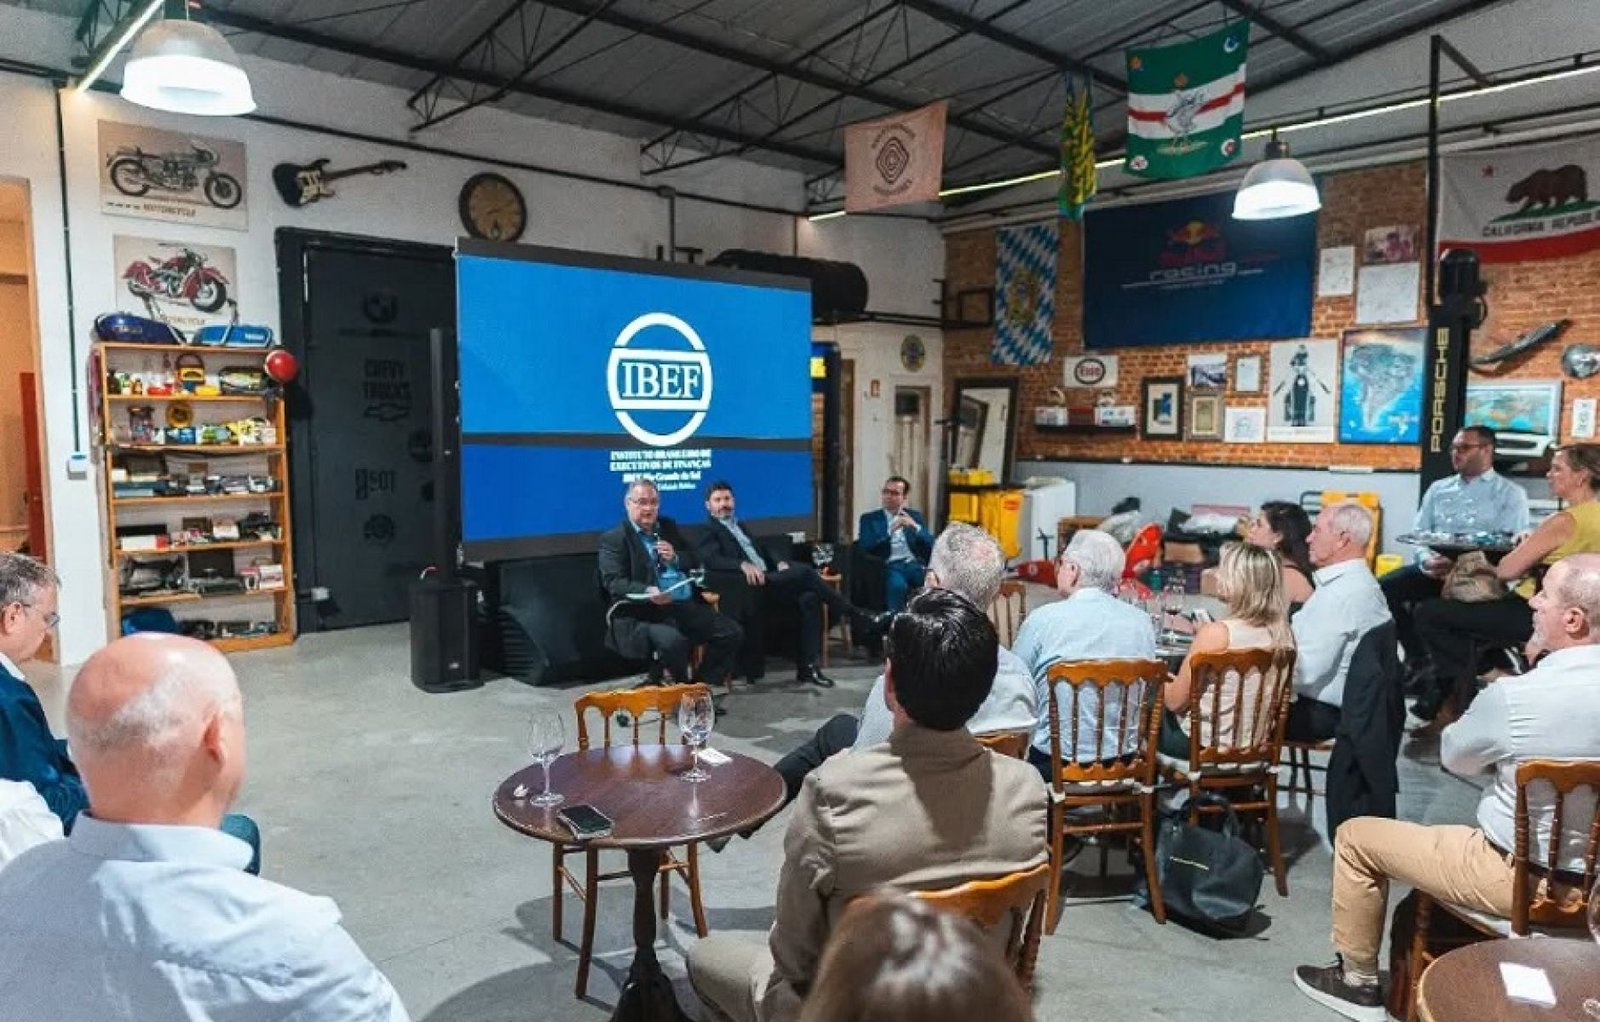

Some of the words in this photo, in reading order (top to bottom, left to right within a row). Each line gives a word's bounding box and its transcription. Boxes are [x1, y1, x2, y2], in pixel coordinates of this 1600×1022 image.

[1482, 221, 1544, 237] CALIFORNIA
[621, 361, 701, 399] IBEF
[1430, 327, 1450, 452] PORSCHE
